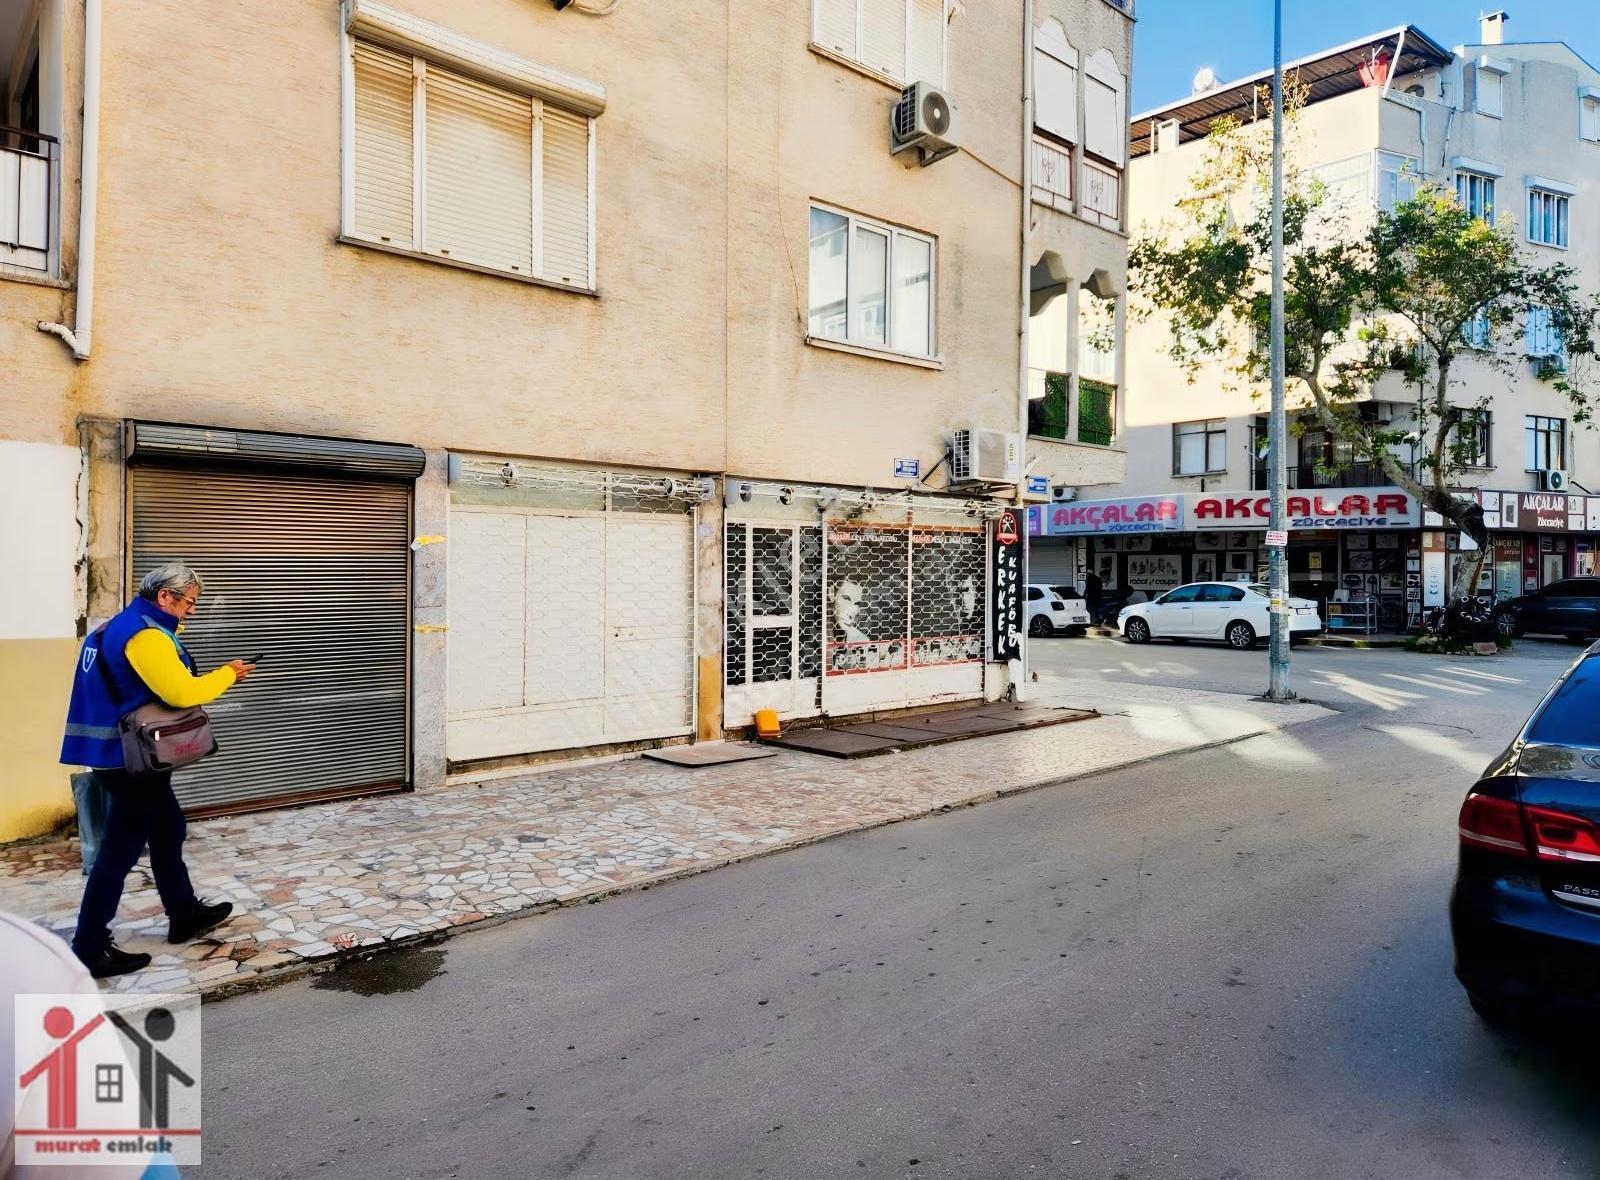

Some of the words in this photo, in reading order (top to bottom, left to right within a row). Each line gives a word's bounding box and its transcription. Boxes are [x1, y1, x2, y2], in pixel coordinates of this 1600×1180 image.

[1053, 502, 1177, 530] AKÇALAR
[1523, 493, 1564, 514] AKÇALAR
[998, 546, 1006, 655] ERKEK
